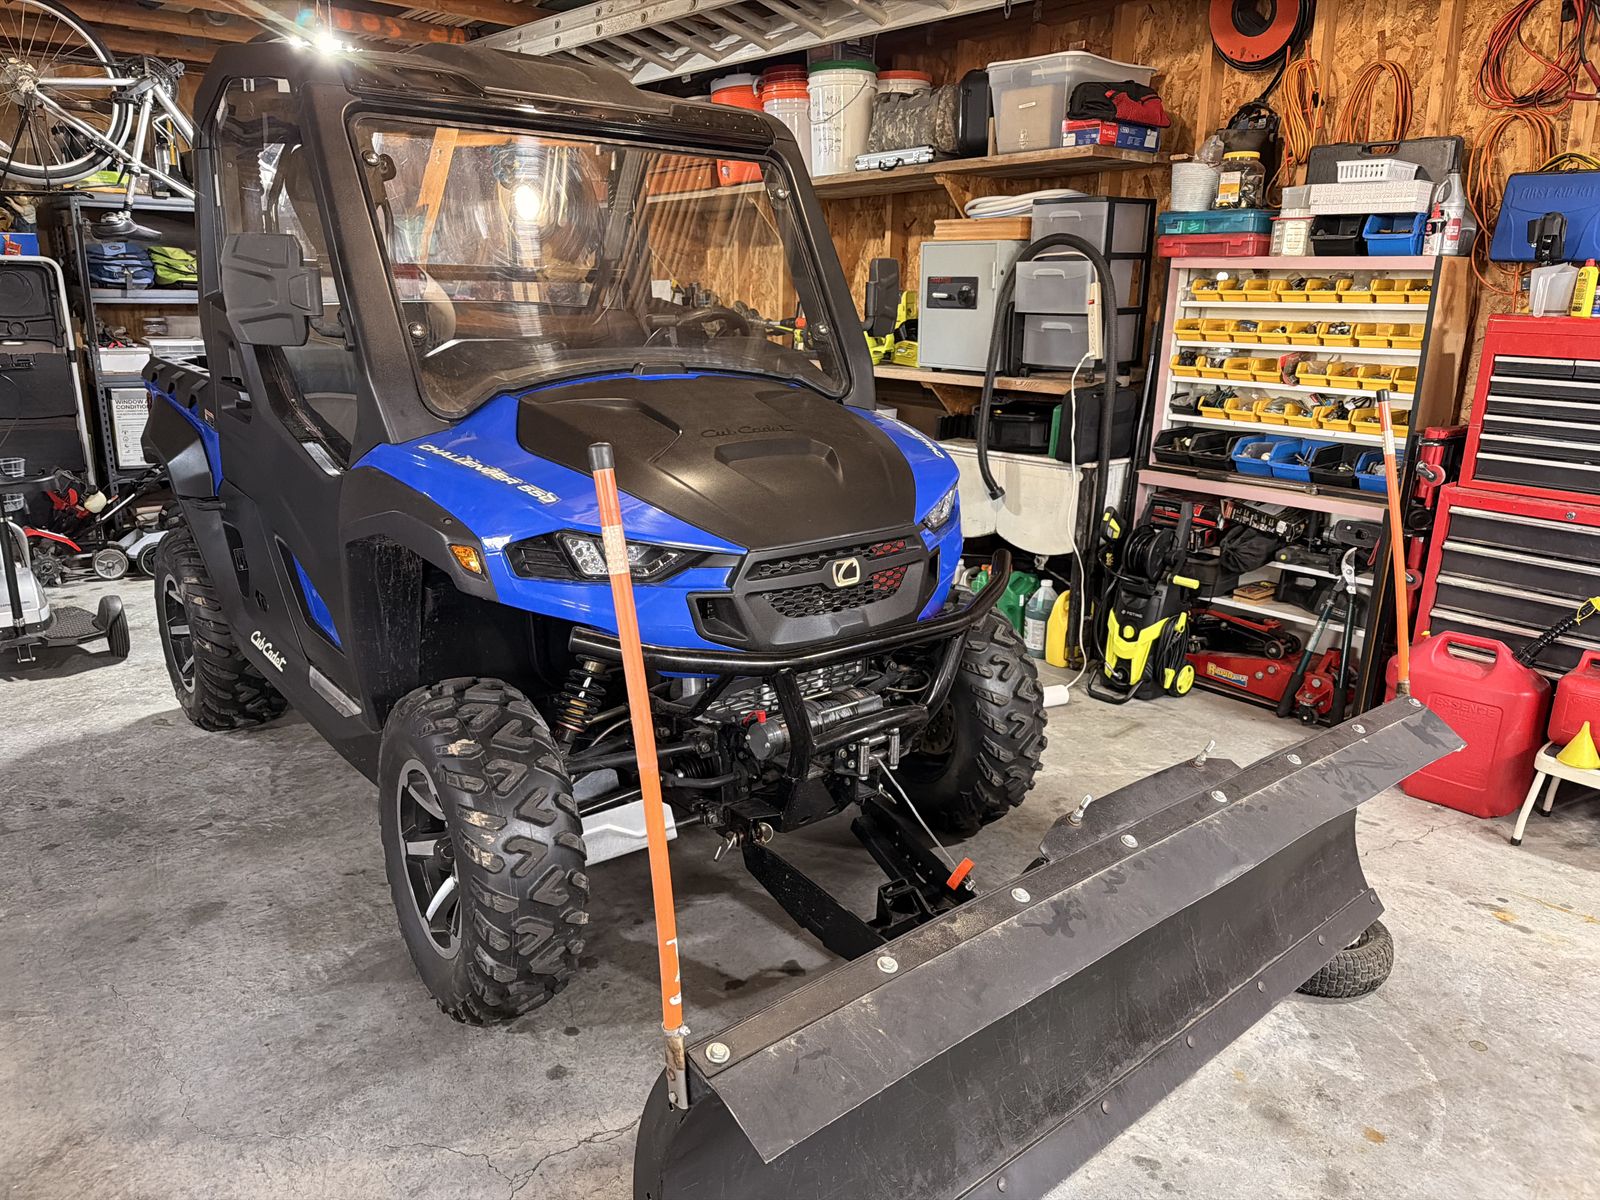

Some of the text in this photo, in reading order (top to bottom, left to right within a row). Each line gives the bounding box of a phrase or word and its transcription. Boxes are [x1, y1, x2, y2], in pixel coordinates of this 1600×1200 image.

[1520, 184, 1597, 200] FIRST AID KIT
[418, 442, 524, 485] CHALLENGER
[250, 630, 287, 673] Cub Cadet
[1433, 695, 1499, 719] ESSENCE
